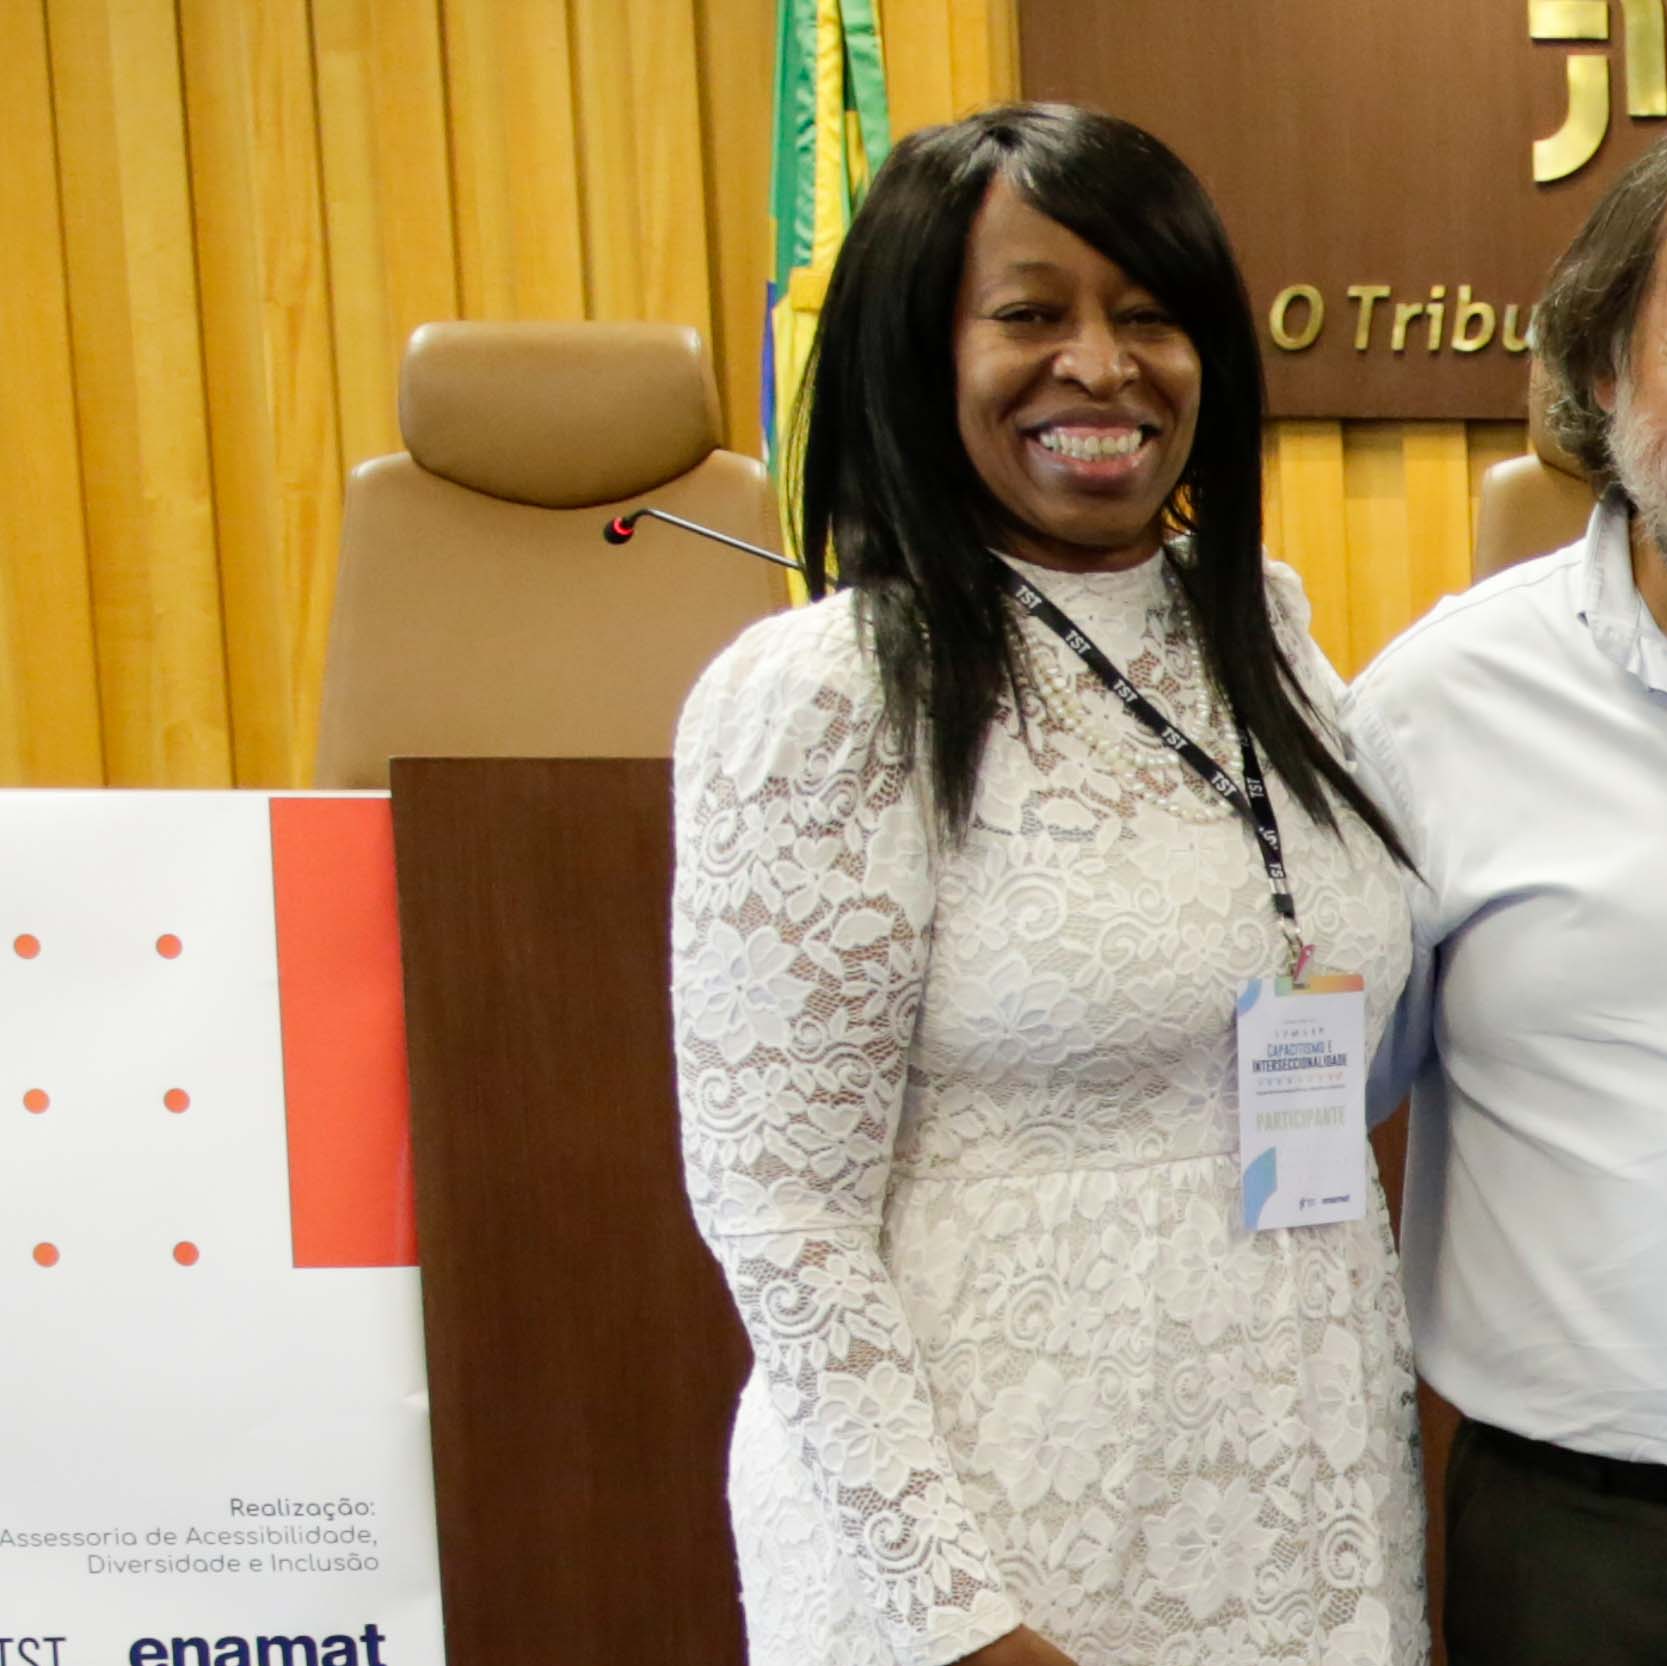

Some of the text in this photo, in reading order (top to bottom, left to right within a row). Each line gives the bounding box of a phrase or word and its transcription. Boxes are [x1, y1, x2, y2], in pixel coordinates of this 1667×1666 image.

[1269, 283, 1325, 351] O
[1015, 583, 1238, 797] TST TST TST TST TST
[229, 1497, 376, 1523] Realização:
[0, 1524, 378, 1548] Assessoria de Acessibilidade,
[88, 1551, 379, 1575] Diversidade e Inclusão
